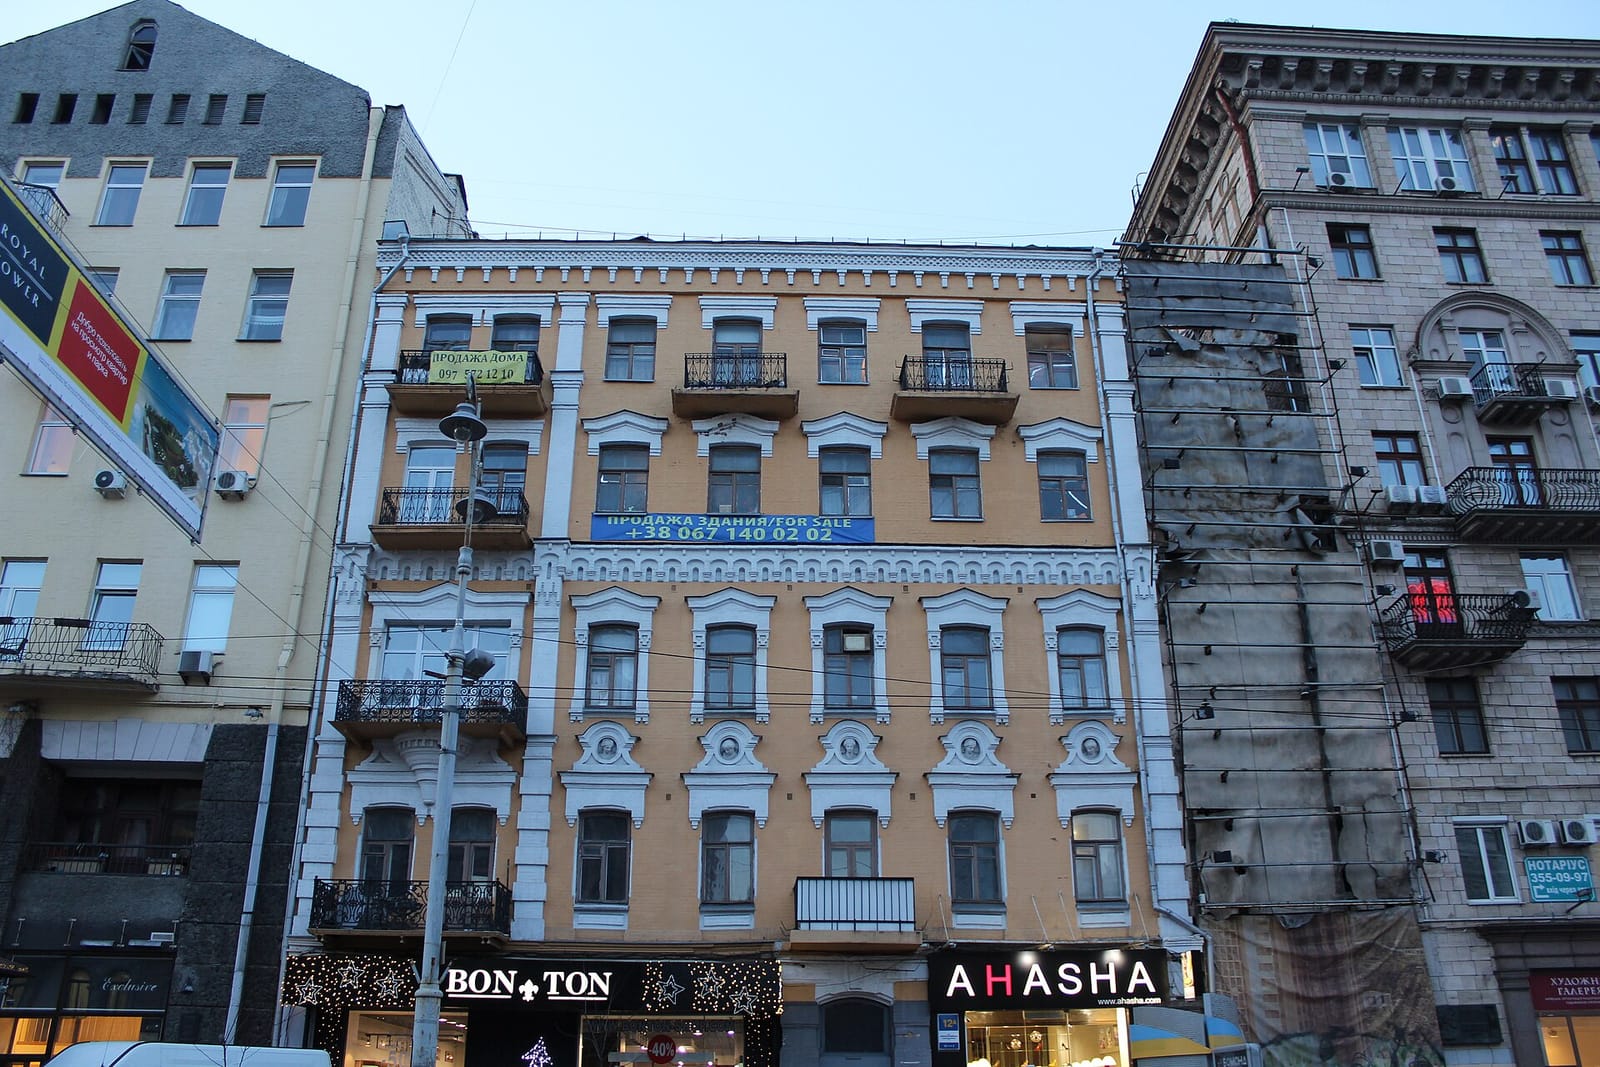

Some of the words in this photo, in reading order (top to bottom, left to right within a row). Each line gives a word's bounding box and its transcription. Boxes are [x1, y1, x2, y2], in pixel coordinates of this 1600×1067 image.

[1, 223, 45, 280] ROYAL
[0, 261, 39, 308] OWER
[77, 311, 96, 337] Добро
[96, 334, 127, 372] пожаловать
[71, 320, 80, 333] на
[79, 329, 107, 362] просмотр
[106, 358, 128, 385] квартир
[432, 353, 488, 364] ПРОДАЖА
[489, 353, 524, 363] ДОМА
[91, 355, 109, 378] парка
[439, 369, 458, 380] 097
[486, 369, 498, 379] 12
[501, 369, 514, 379] 10
[607, 515, 693, 526] ПРОДАЖА
[698, 516, 808, 528] ЗДАНИЯ/FOR
[812, 517, 852, 528] SALE
[625, 526, 671, 539] +38
[677, 526, 718, 540] 067
[726, 527, 766, 540] 140
[772, 527, 799, 540] 02
[806, 528, 832, 541] 02
[1527, 859, 1586, 871] НОТАРІУС
[1530, 872, 1588, 883] 355-09-97
[102, 977, 158, 992] Exclusive
[445, 969, 518, 994] BON
[543, 971, 613, 996] TON
[946, 961, 1156, 997] AHASHA
[1098, 997, 1162, 1006] www.ahasha.com
[651, 1042, 675, 1057] 40%
